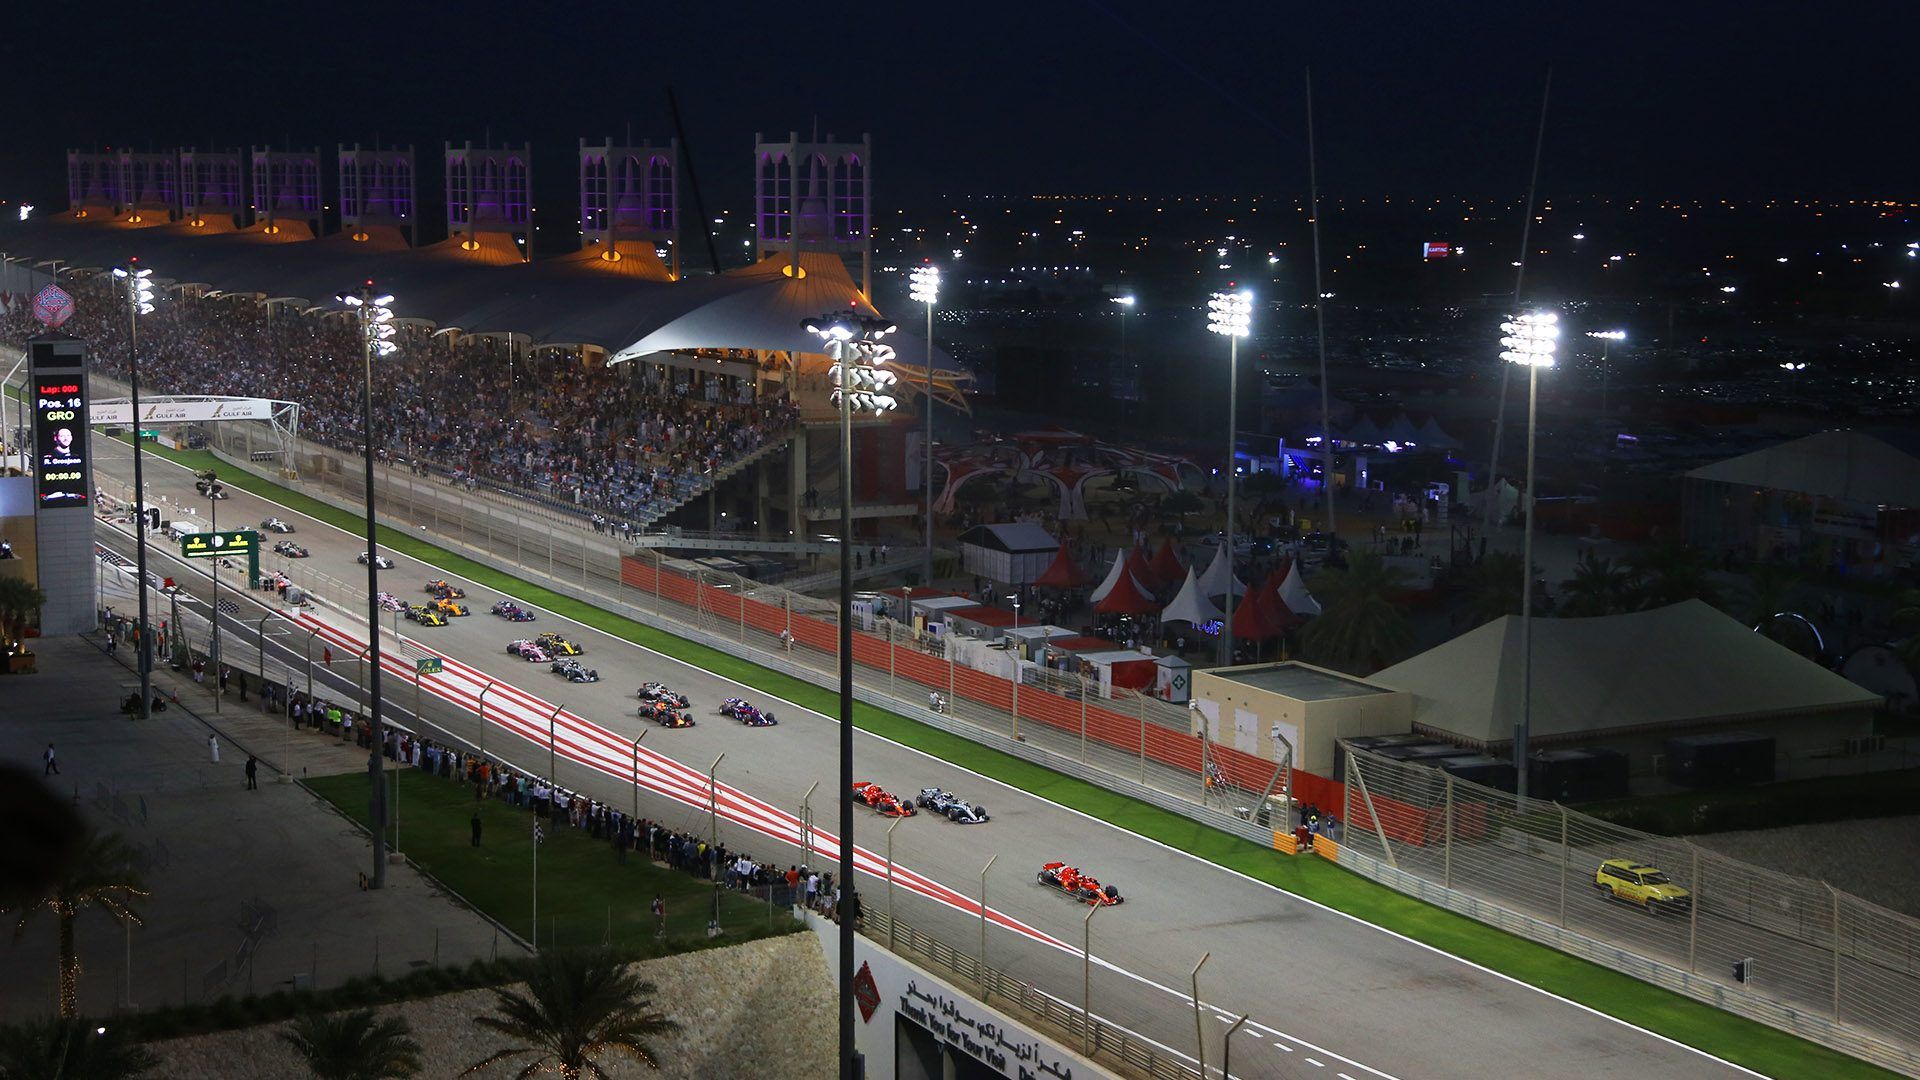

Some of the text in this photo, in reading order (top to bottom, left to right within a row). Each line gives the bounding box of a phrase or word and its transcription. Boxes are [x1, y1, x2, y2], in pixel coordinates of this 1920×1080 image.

[40, 385, 78, 394] Lap: 000
[39, 398, 81, 408] Pos. 16
[47, 411, 75, 420] GRO
[45, 472, 82, 481] 00:00.00
[900, 995, 1006, 1072] Thank You for Your Visit
